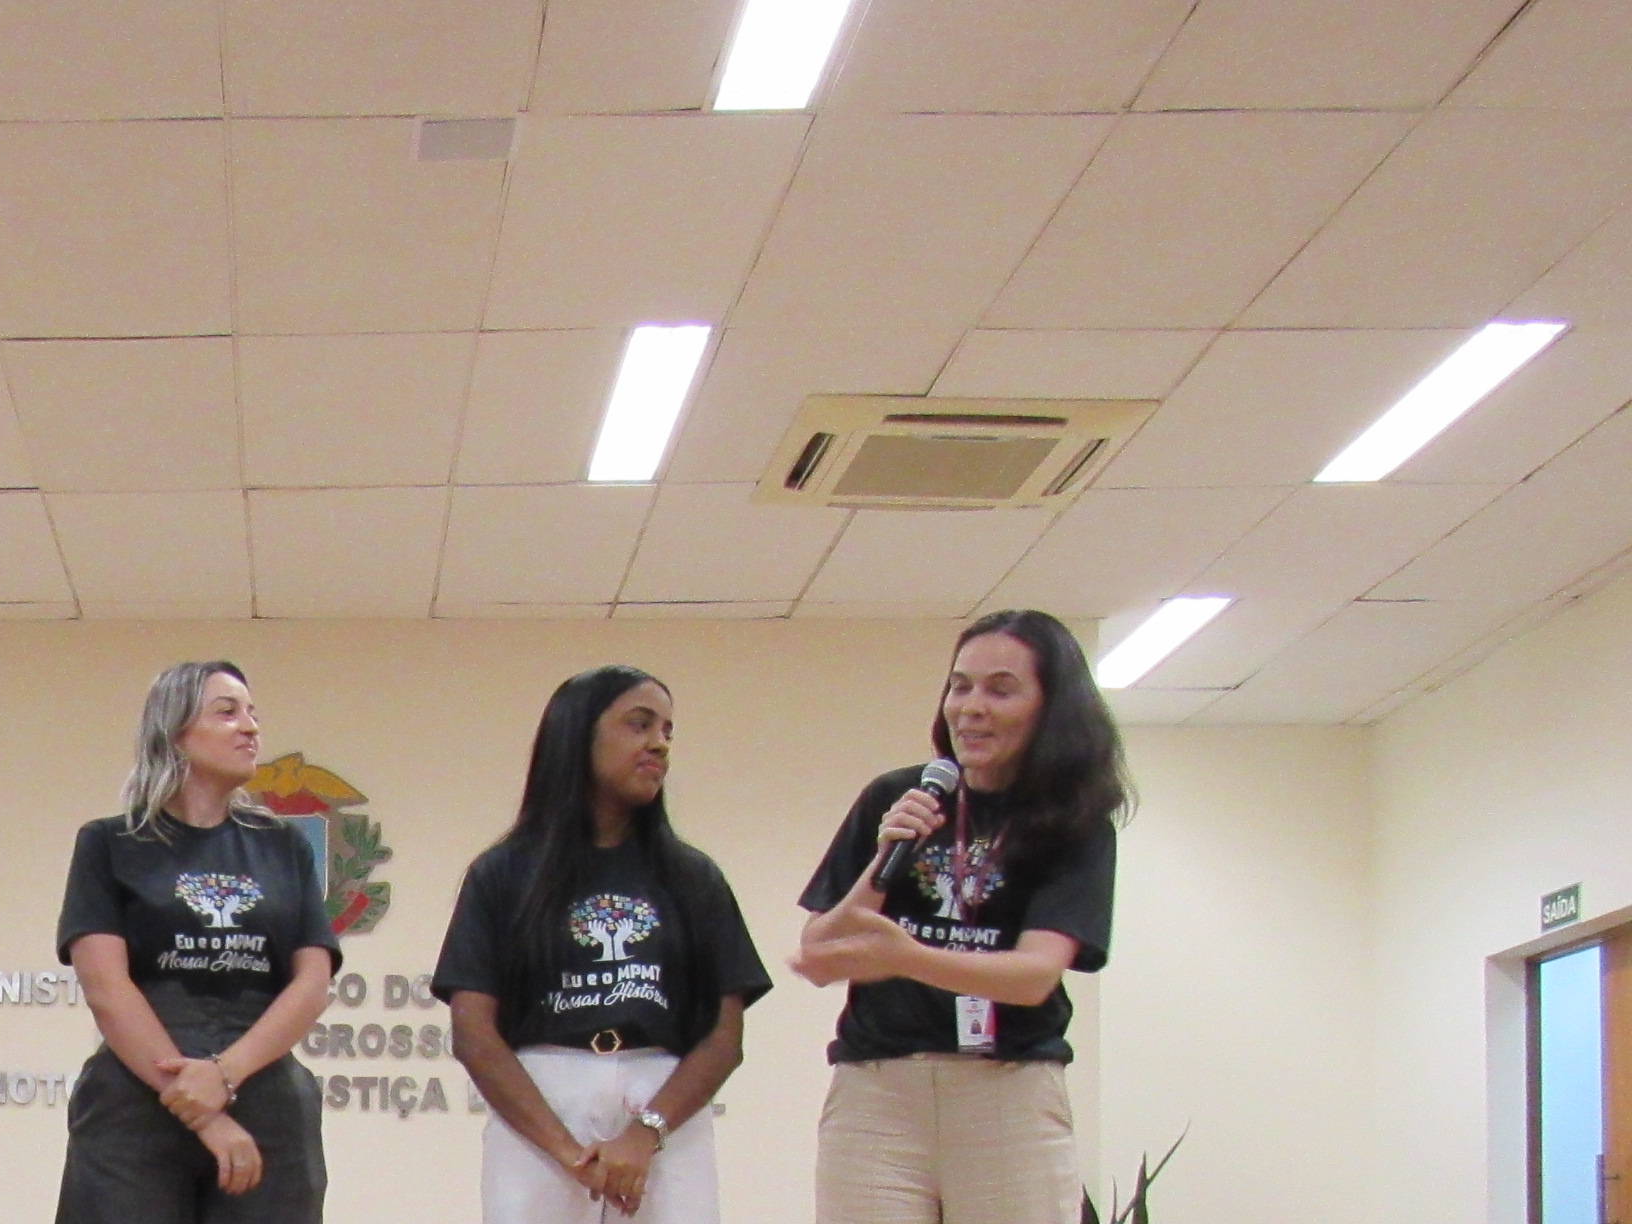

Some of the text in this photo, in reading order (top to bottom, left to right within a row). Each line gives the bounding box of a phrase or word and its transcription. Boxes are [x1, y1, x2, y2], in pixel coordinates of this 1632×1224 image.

[1542, 895, 1576, 924] SAÍDA
[174, 934, 194, 950] Eu
[198, 937, 208, 949] e
[211, 937, 222, 949] o
[587, 973, 598, 986] e
[602, 972, 613, 984] o
[617, 963, 661, 982] MPMT
[301, 1021, 453, 1060] GROSS
